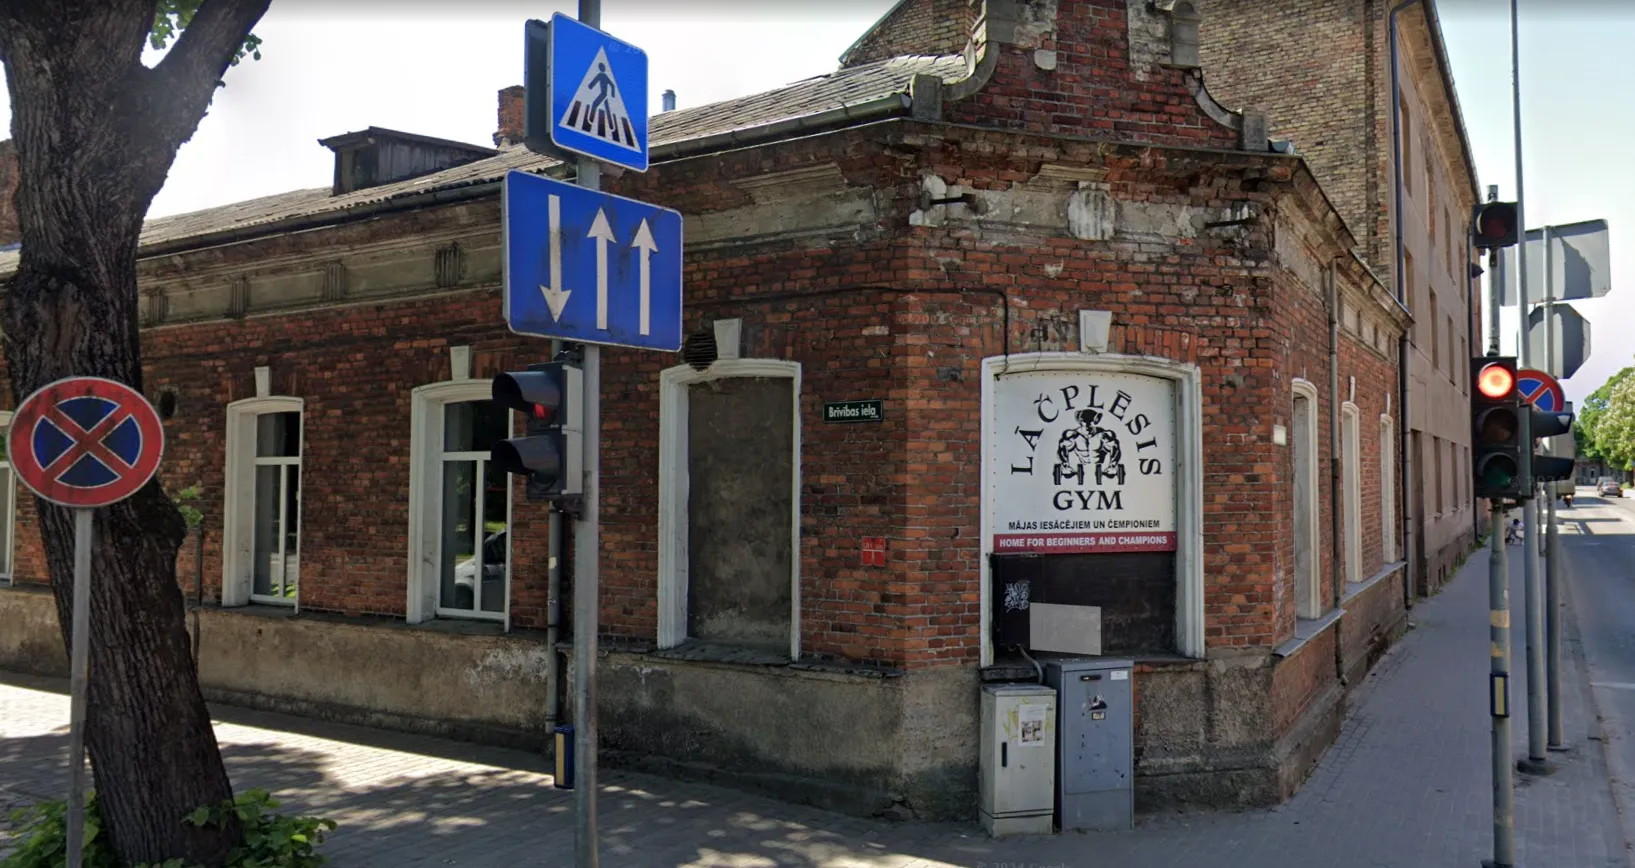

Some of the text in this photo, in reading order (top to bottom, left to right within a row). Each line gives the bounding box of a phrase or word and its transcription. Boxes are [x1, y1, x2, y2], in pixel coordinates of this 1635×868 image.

[861, 404, 876, 416] iela
[1011, 384, 1161, 476] LĀČPLĒSIS
[1053, 490, 1124, 511] GYM
[1008, 518, 1160, 530] MĀJAS IESĀCĒJIEM UN ČEMPIONIEM
[999, 535, 1168, 548] HOME FOR BEGINNERS AND CHAMPIONS
